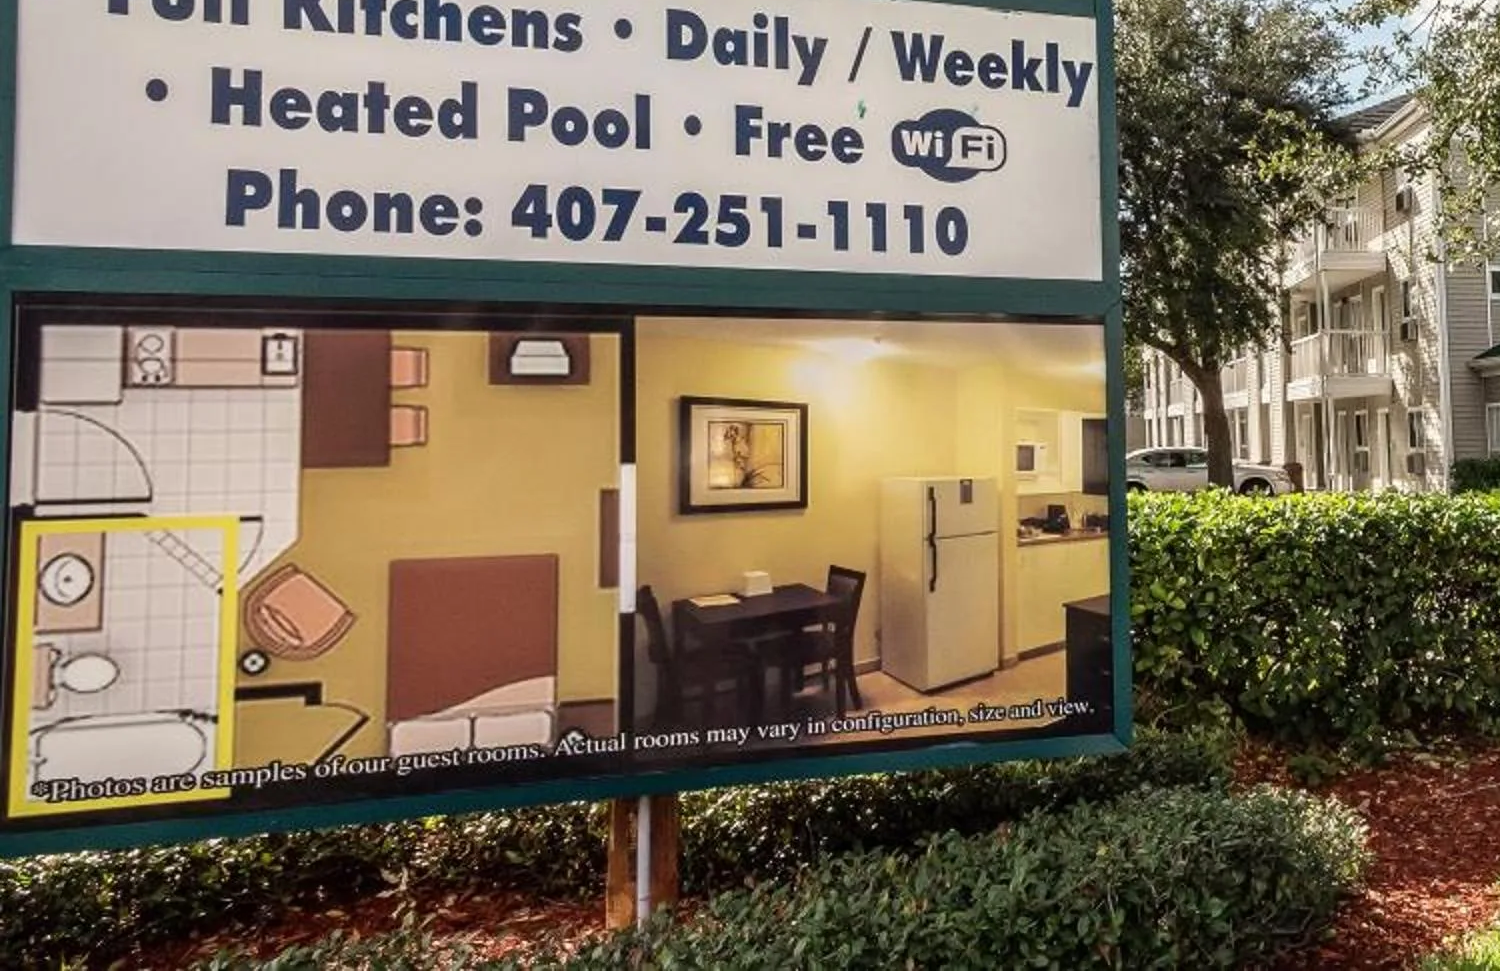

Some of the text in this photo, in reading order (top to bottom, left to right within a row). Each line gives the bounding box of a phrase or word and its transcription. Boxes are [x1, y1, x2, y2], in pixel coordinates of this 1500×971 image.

[666, 8, 828, 86] Daily
[891, 30, 1092, 107] Weekly
[211, 66, 478, 139] Heated
[507, 86, 651, 150] Pool
[735, 104, 864, 164] Free
[225, 168, 968, 256] Phone: 407-251-1110
[153, 773, 195, 793] are
[203, 761, 306, 789] samples
[315, 755, 341, 777] of
[349, 757, 391, 775] our
[398, 748, 460, 776] guest
[468, 742, 546, 764] rooms.
[554, 733, 626, 758] Actual
[634, 730, 700, 750] rooms
[707, 726, 750, 746] may
[757, 721, 801, 743] vary
[808, 717, 826, 734] in
[831, 706, 963, 733] configuration,
[969, 703, 1004, 722] size
[1011, 699, 1042, 718] and
[1048, 697, 1095, 717] view.
